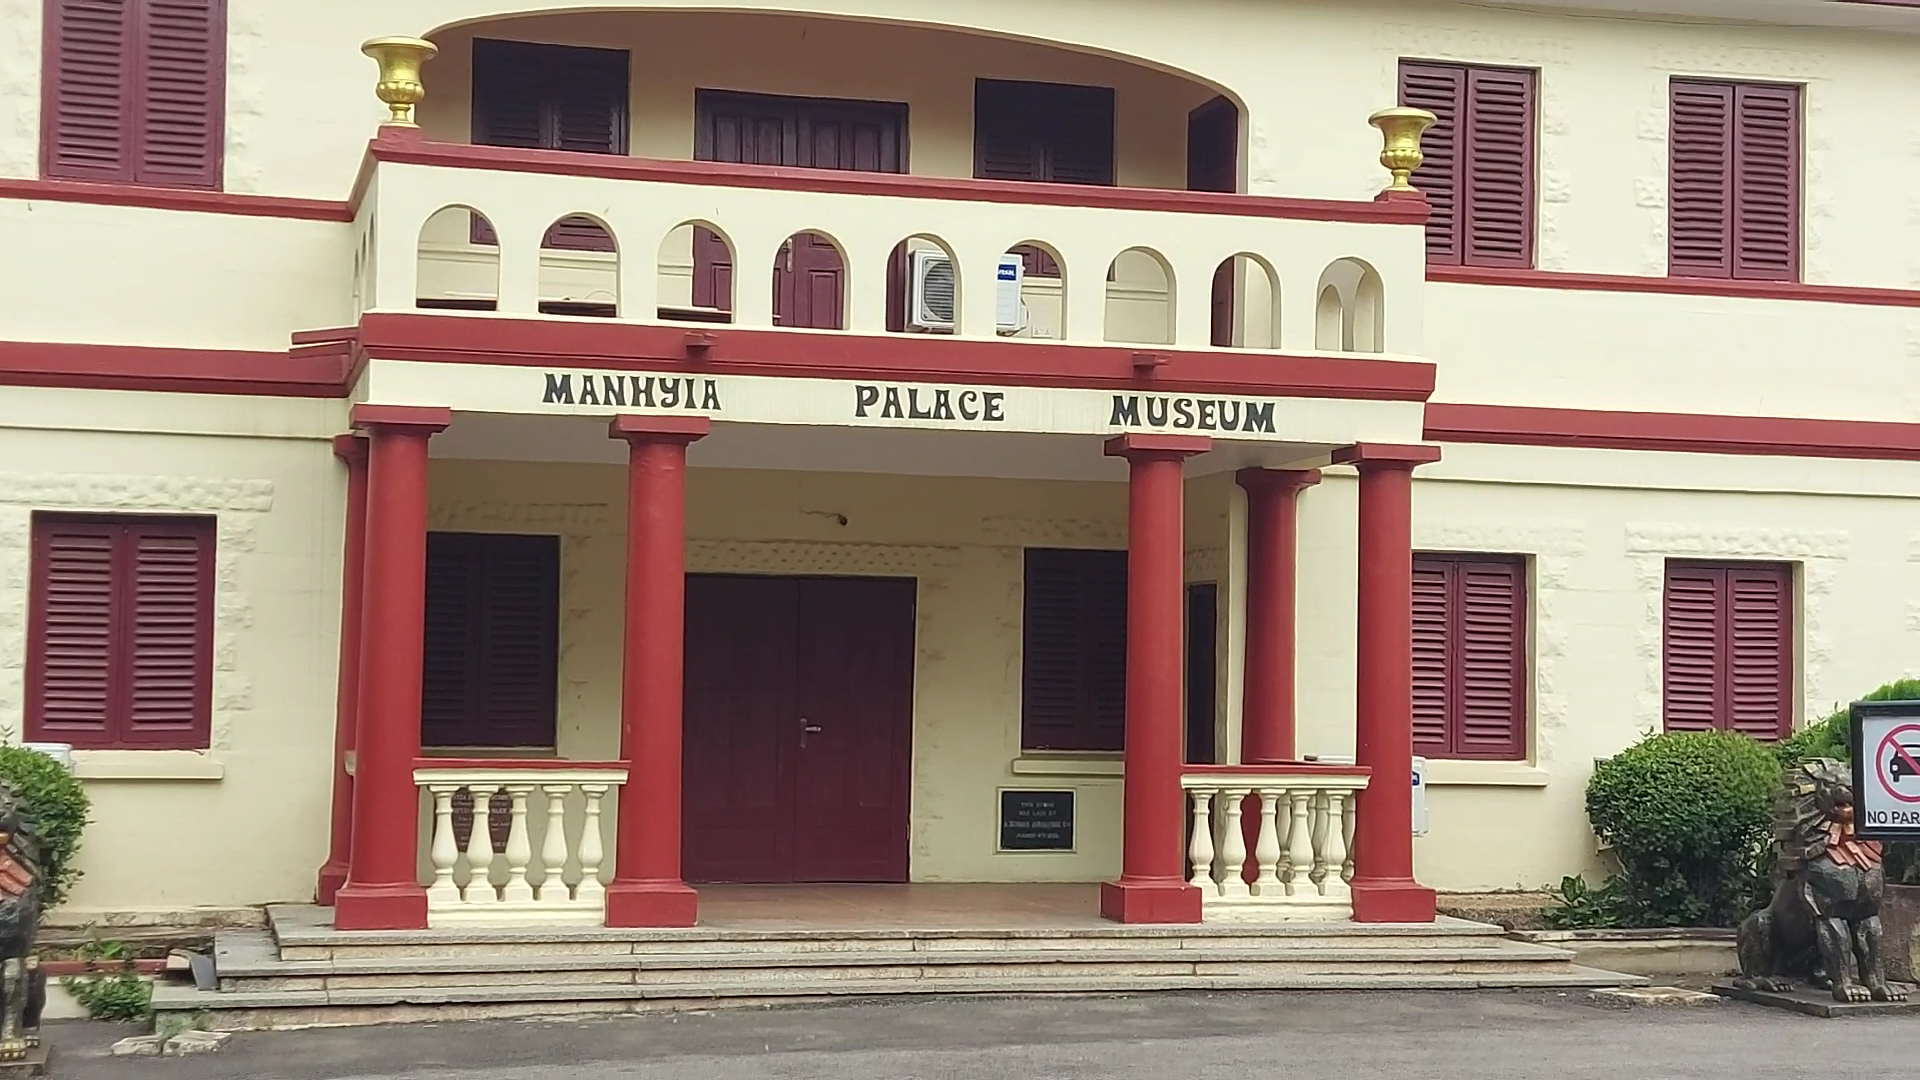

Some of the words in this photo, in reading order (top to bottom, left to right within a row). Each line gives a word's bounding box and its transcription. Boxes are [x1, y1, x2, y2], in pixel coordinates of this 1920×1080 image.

[543, 373, 722, 411] MANHYIA
[855, 385, 1004, 422] PALACE
[1109, 395, 1276, 433] MUSEUM
[1868, 811, 1888, 824] NO
